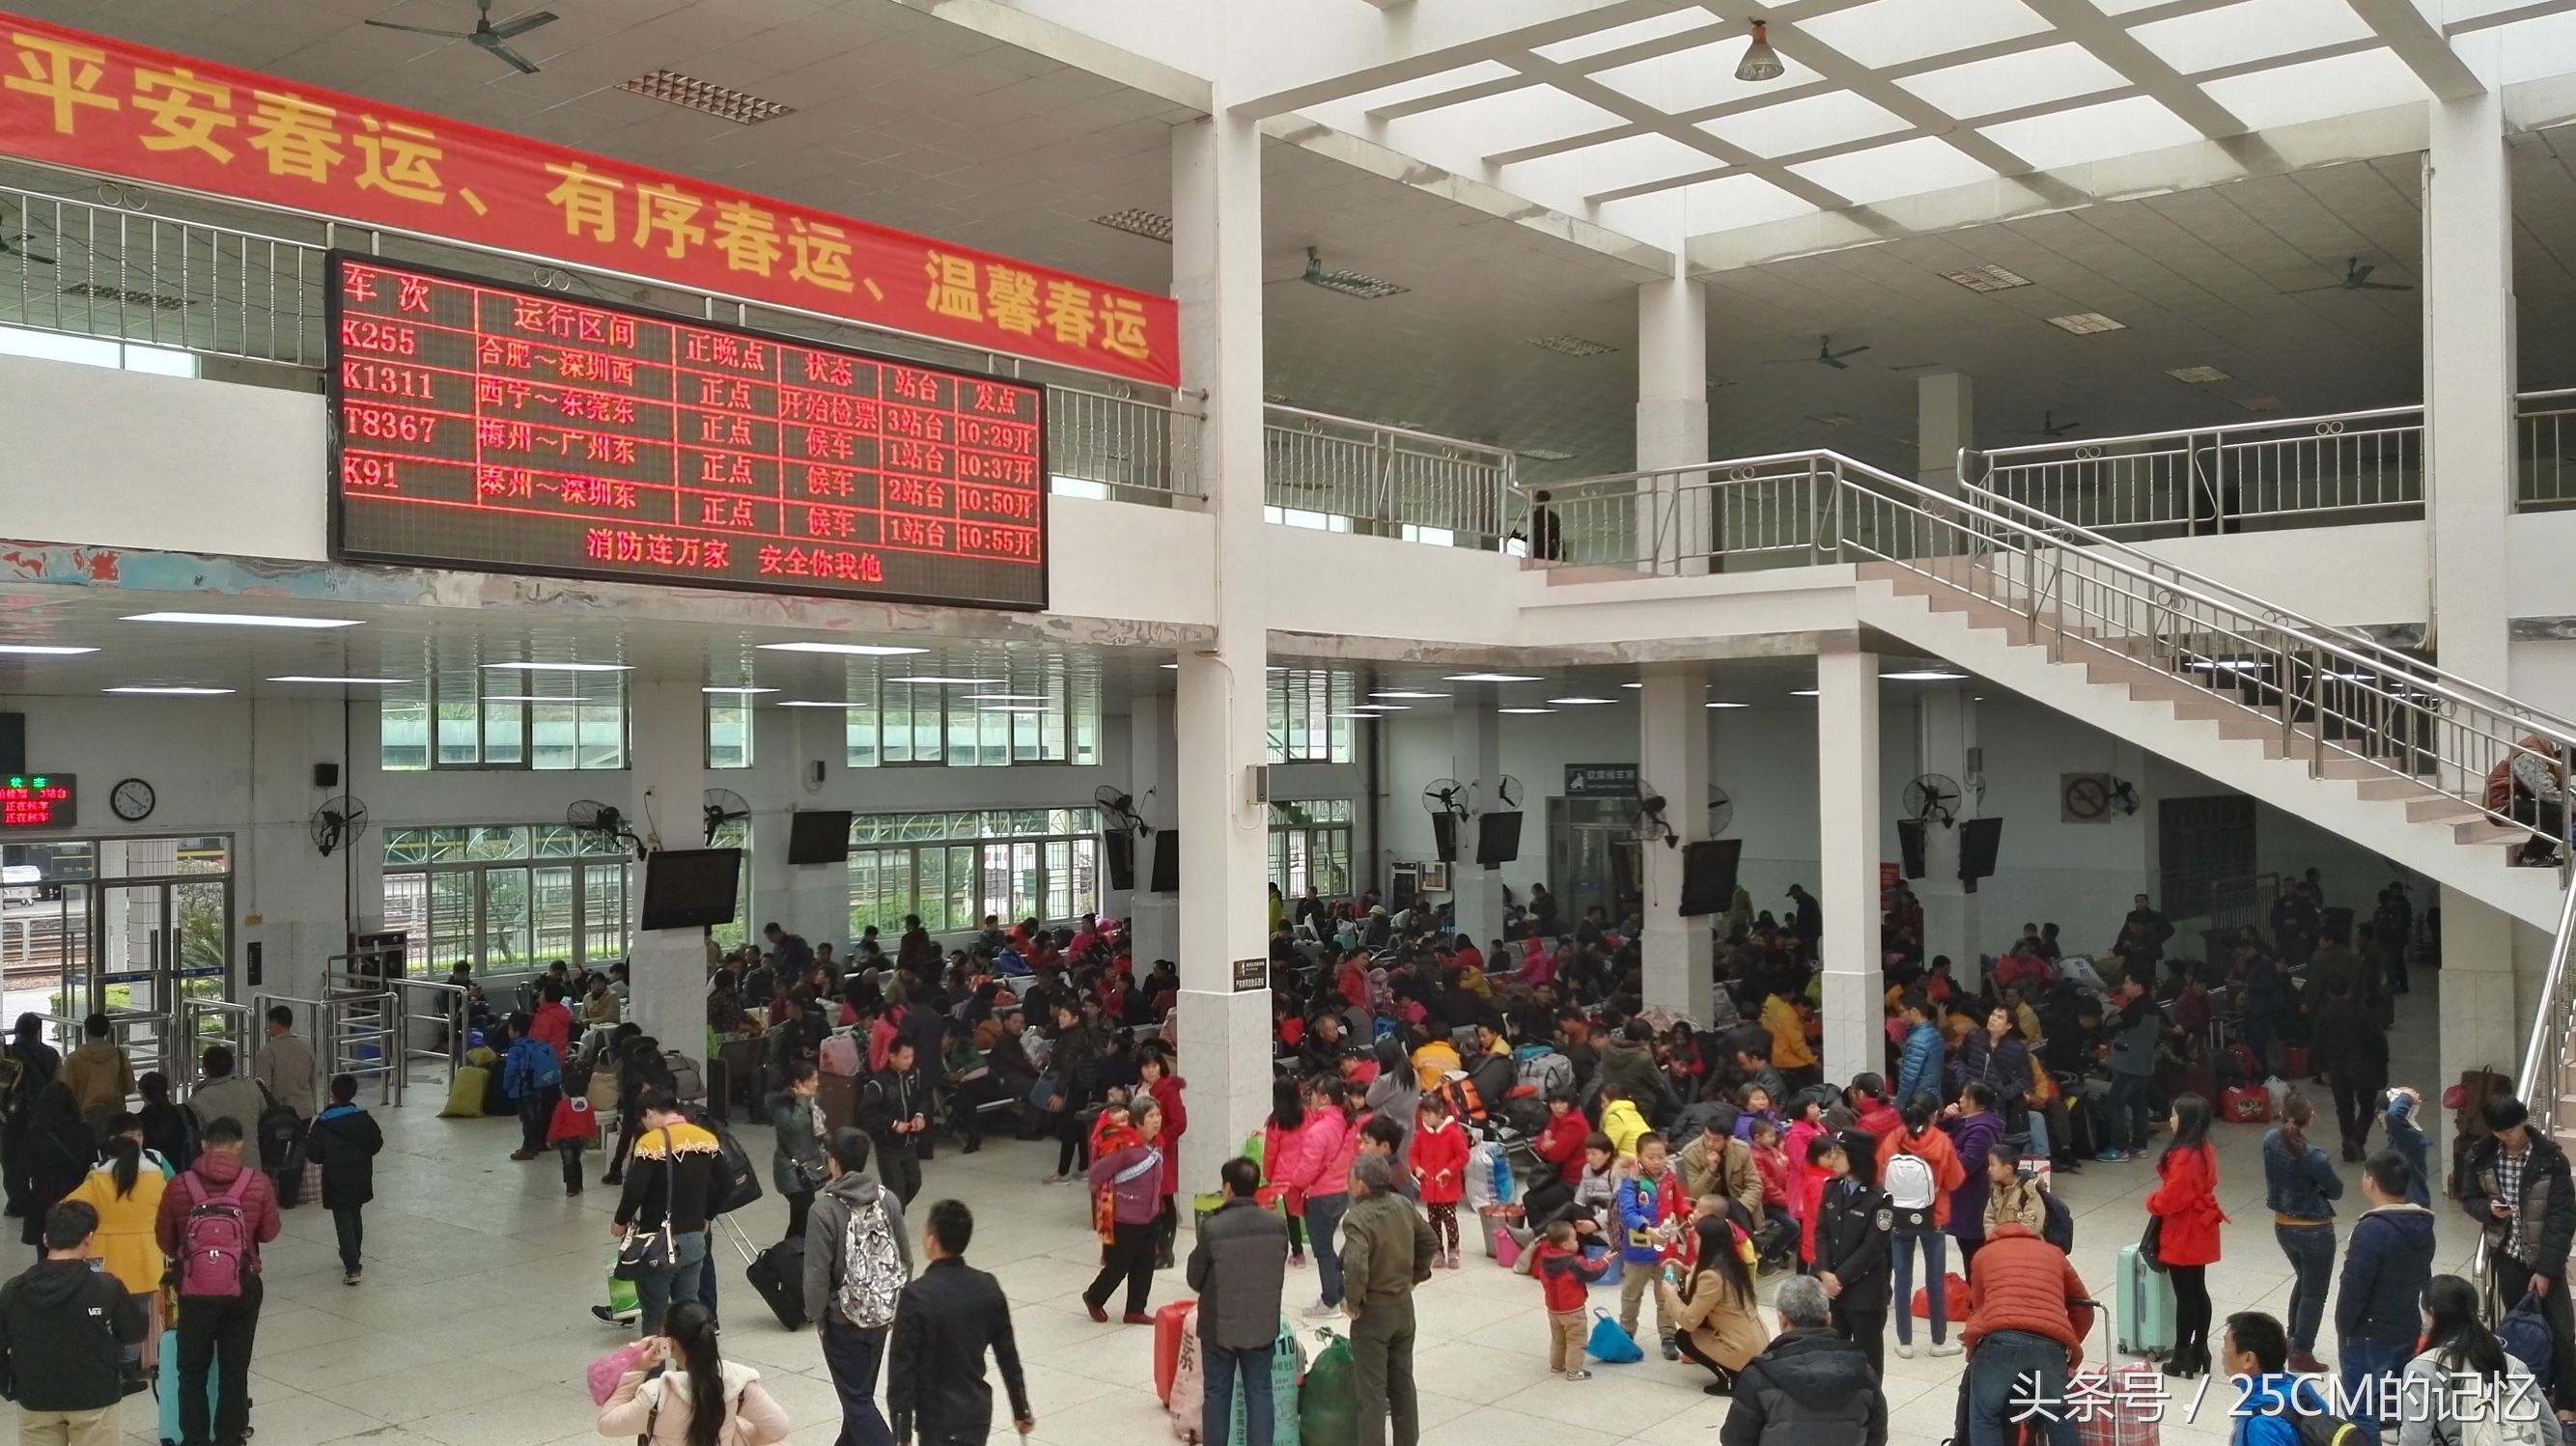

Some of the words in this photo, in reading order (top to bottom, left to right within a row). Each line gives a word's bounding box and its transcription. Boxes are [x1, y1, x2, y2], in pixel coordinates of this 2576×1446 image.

[342, 319, 416, 356] K255
[700, 377, 752, 410] 正点
[780, 390, 878, 431] 开始检票
[887, 407, 944, 442] 3站台
[959, 420, 1033, 456] 10:29开
[514, 299, 635, 349] 运行区间
[685, 333, 765, 373] 正晚点
[803, 351, 854, 388] 状态
[893, 369, 938, 403] 站台
[974, 383, 1017, 415] 发点
[342, 361, 434, 400] K1311
[700, 414, 753, 446] 正点
[805, 427, 855, 460] 候车
[889, 442, 945, 475] 1站台
[959, 454, 1034, 486] 10:37开
[343, 405, 435, 444] T8367
[701, 454, 753, 486] 正点
[806, 464, 856, 497] 候车
[889, 477, 946, 510] 2站台
[960, 486, 1034, 519] 10:50开
[343, 456, 399, 489] K91
[701, 496, 755, 527] 正点
[807, 506, 857, 538] 候车
[890, 516, 947, 548] 1站台
[960, 525, 1035, 557] 10:55开
[586, 526, 731, 570] 消防连万家
[758, 543, 884, 583] 安全你我他
